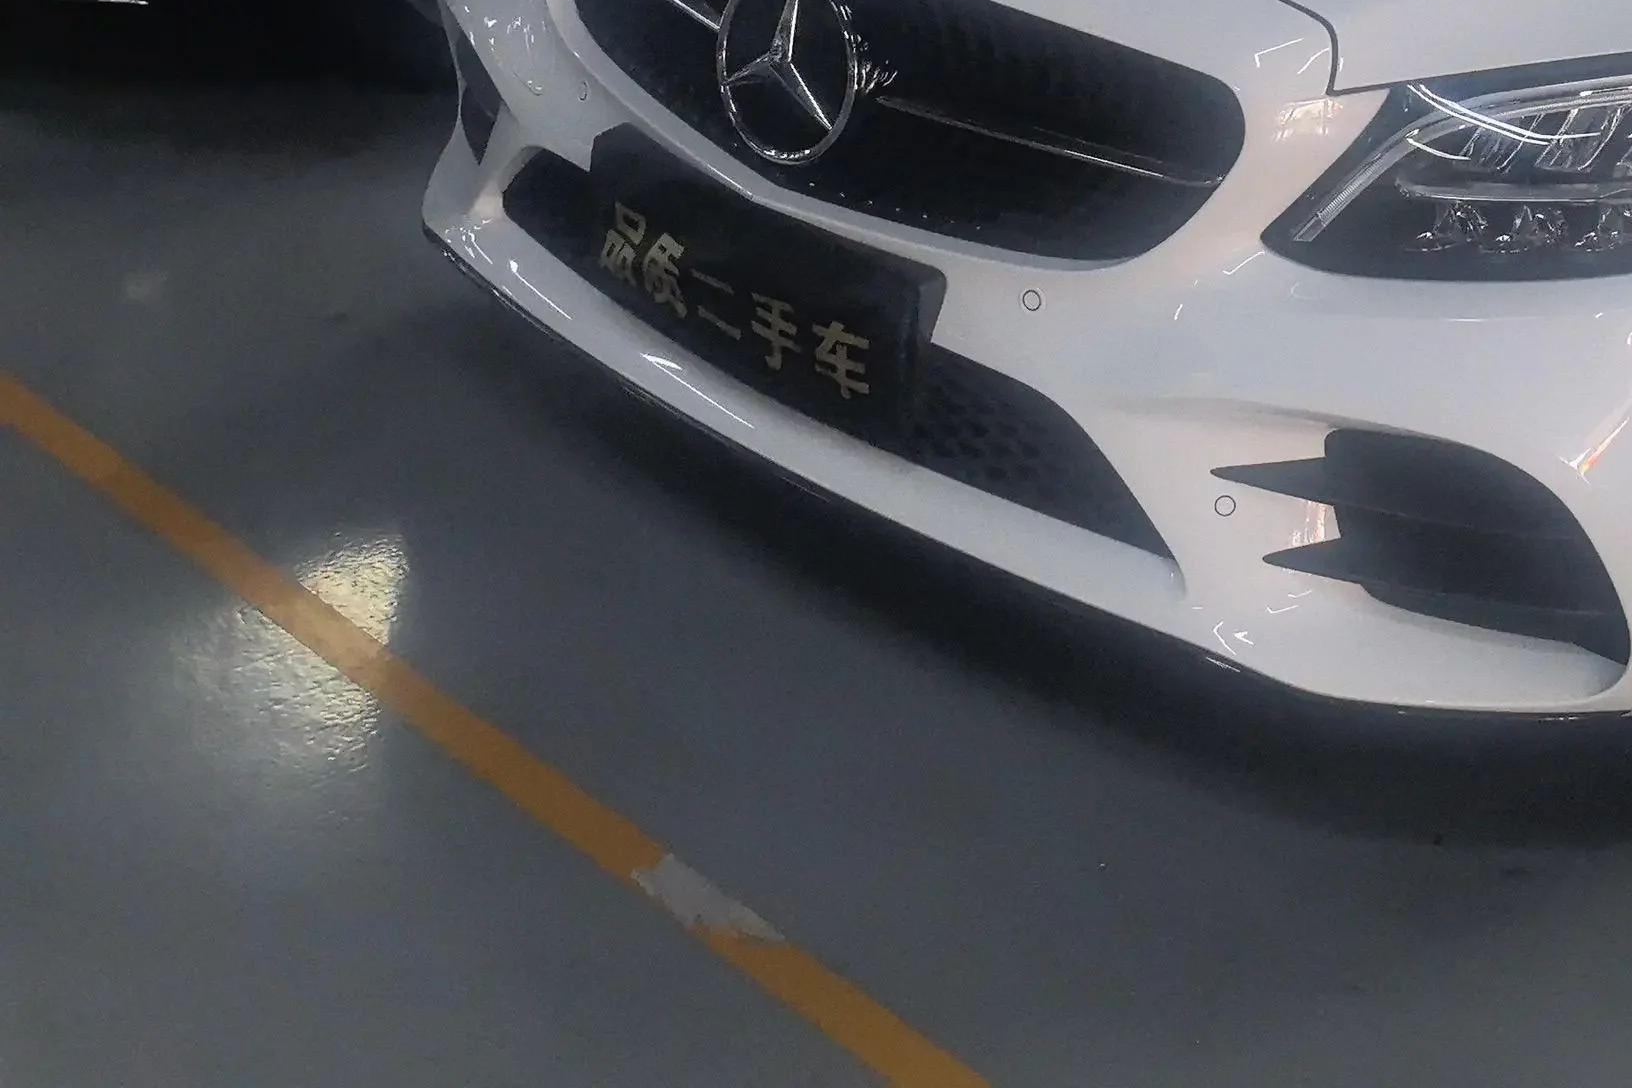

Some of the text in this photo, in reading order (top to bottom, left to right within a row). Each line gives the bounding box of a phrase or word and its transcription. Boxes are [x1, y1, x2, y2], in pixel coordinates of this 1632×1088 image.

[600, 201, 871, 400] 品质二手车
